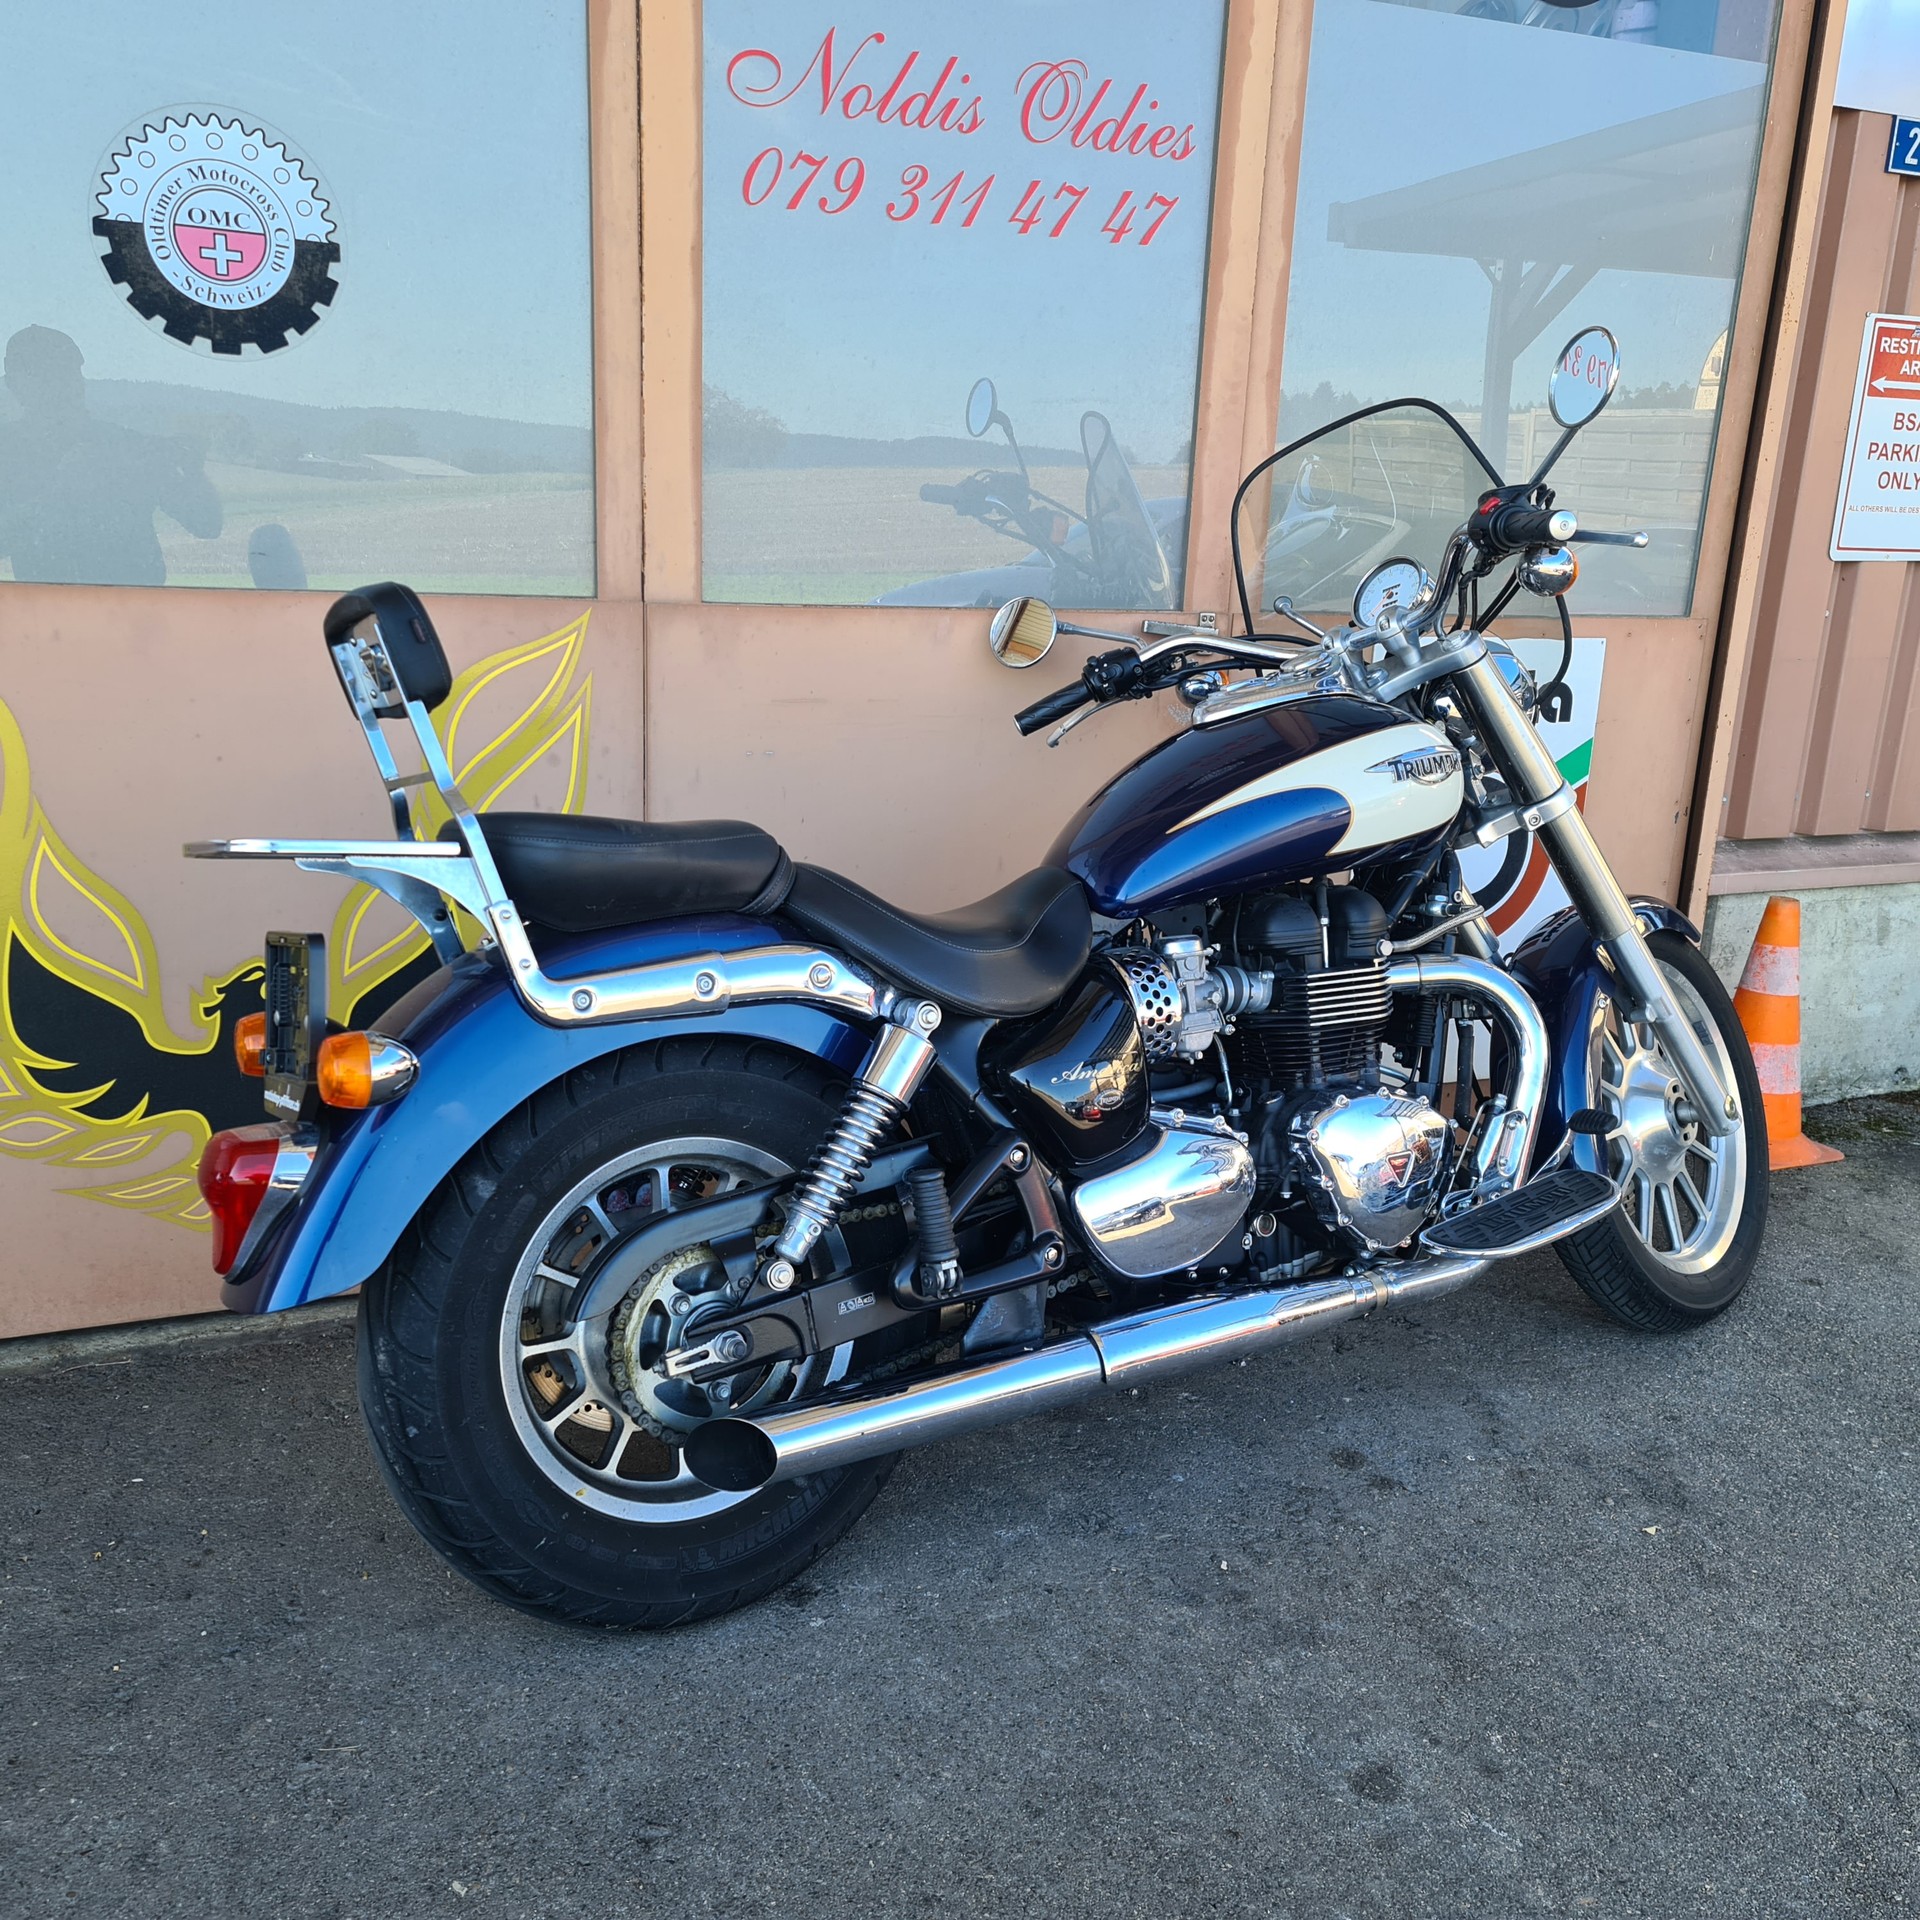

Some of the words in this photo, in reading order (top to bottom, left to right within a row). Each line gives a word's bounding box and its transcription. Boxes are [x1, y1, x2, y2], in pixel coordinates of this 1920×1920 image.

[727, 26, 985, 134] Noldis
[1015, 59, 1196, 160] Oldies
[149, 177, 183, 261] Oldtimer
[187, 165, 279, 221] Motocross
[270, 227, 290, 273] Club
[187, 207, 251, 230] OMC
[742, 147, 866, 213] 079
[886, 165, 995, 227] 311
[1008, 180, 1090, 237] 47
[1101, 191, 1179, 245] 47
[1893, 412, 1920, 431] BS
[1388, 753, 1460, 782] TRIUMPH
